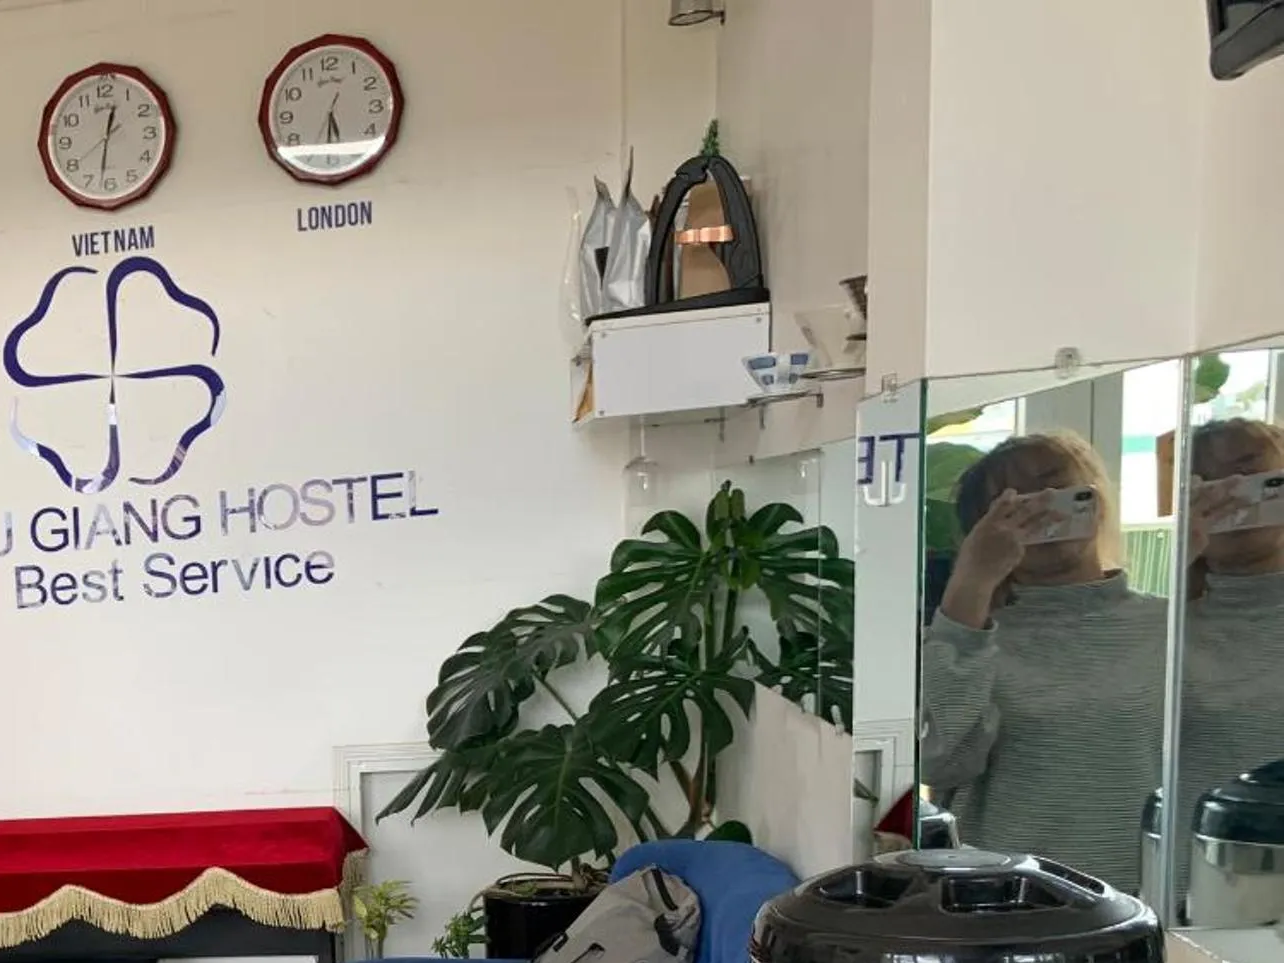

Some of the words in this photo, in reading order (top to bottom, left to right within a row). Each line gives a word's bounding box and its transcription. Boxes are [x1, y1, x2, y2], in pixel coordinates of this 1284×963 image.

[320, 56, 339, 72] 12
[302, 67, 314, 82] 11
[363, 76, 377, 91] 2
[96, 84, 114, 98] 12
[285, 87, 302, 103] 10
[79, 94, 90, 108] 11
[368, 99, 384, 114] 3
[137, 104, 150, 118] 2
[279, 111, 294, 125] 9
[63, 113, 79, 127] 10
[143, 126, 157, 140] 3
[364, 123, 376, 137] 4
[59, 136, 72, 150] 9
[140, 150, 151, 163] 4
[66, 159, 79, 172] 8
[83, 174, 94, 189] 7
[126, 169, 138, 182] 5
[104, 178, 117, 191] 6
[297, 200, 372, 232] LONDON
[30, 494, 202, 552] GIANG
[218, 470, 439, 536] HOSTEL
[15, 560, 124, 609] Best
[142, 550, 335, 598] Service
